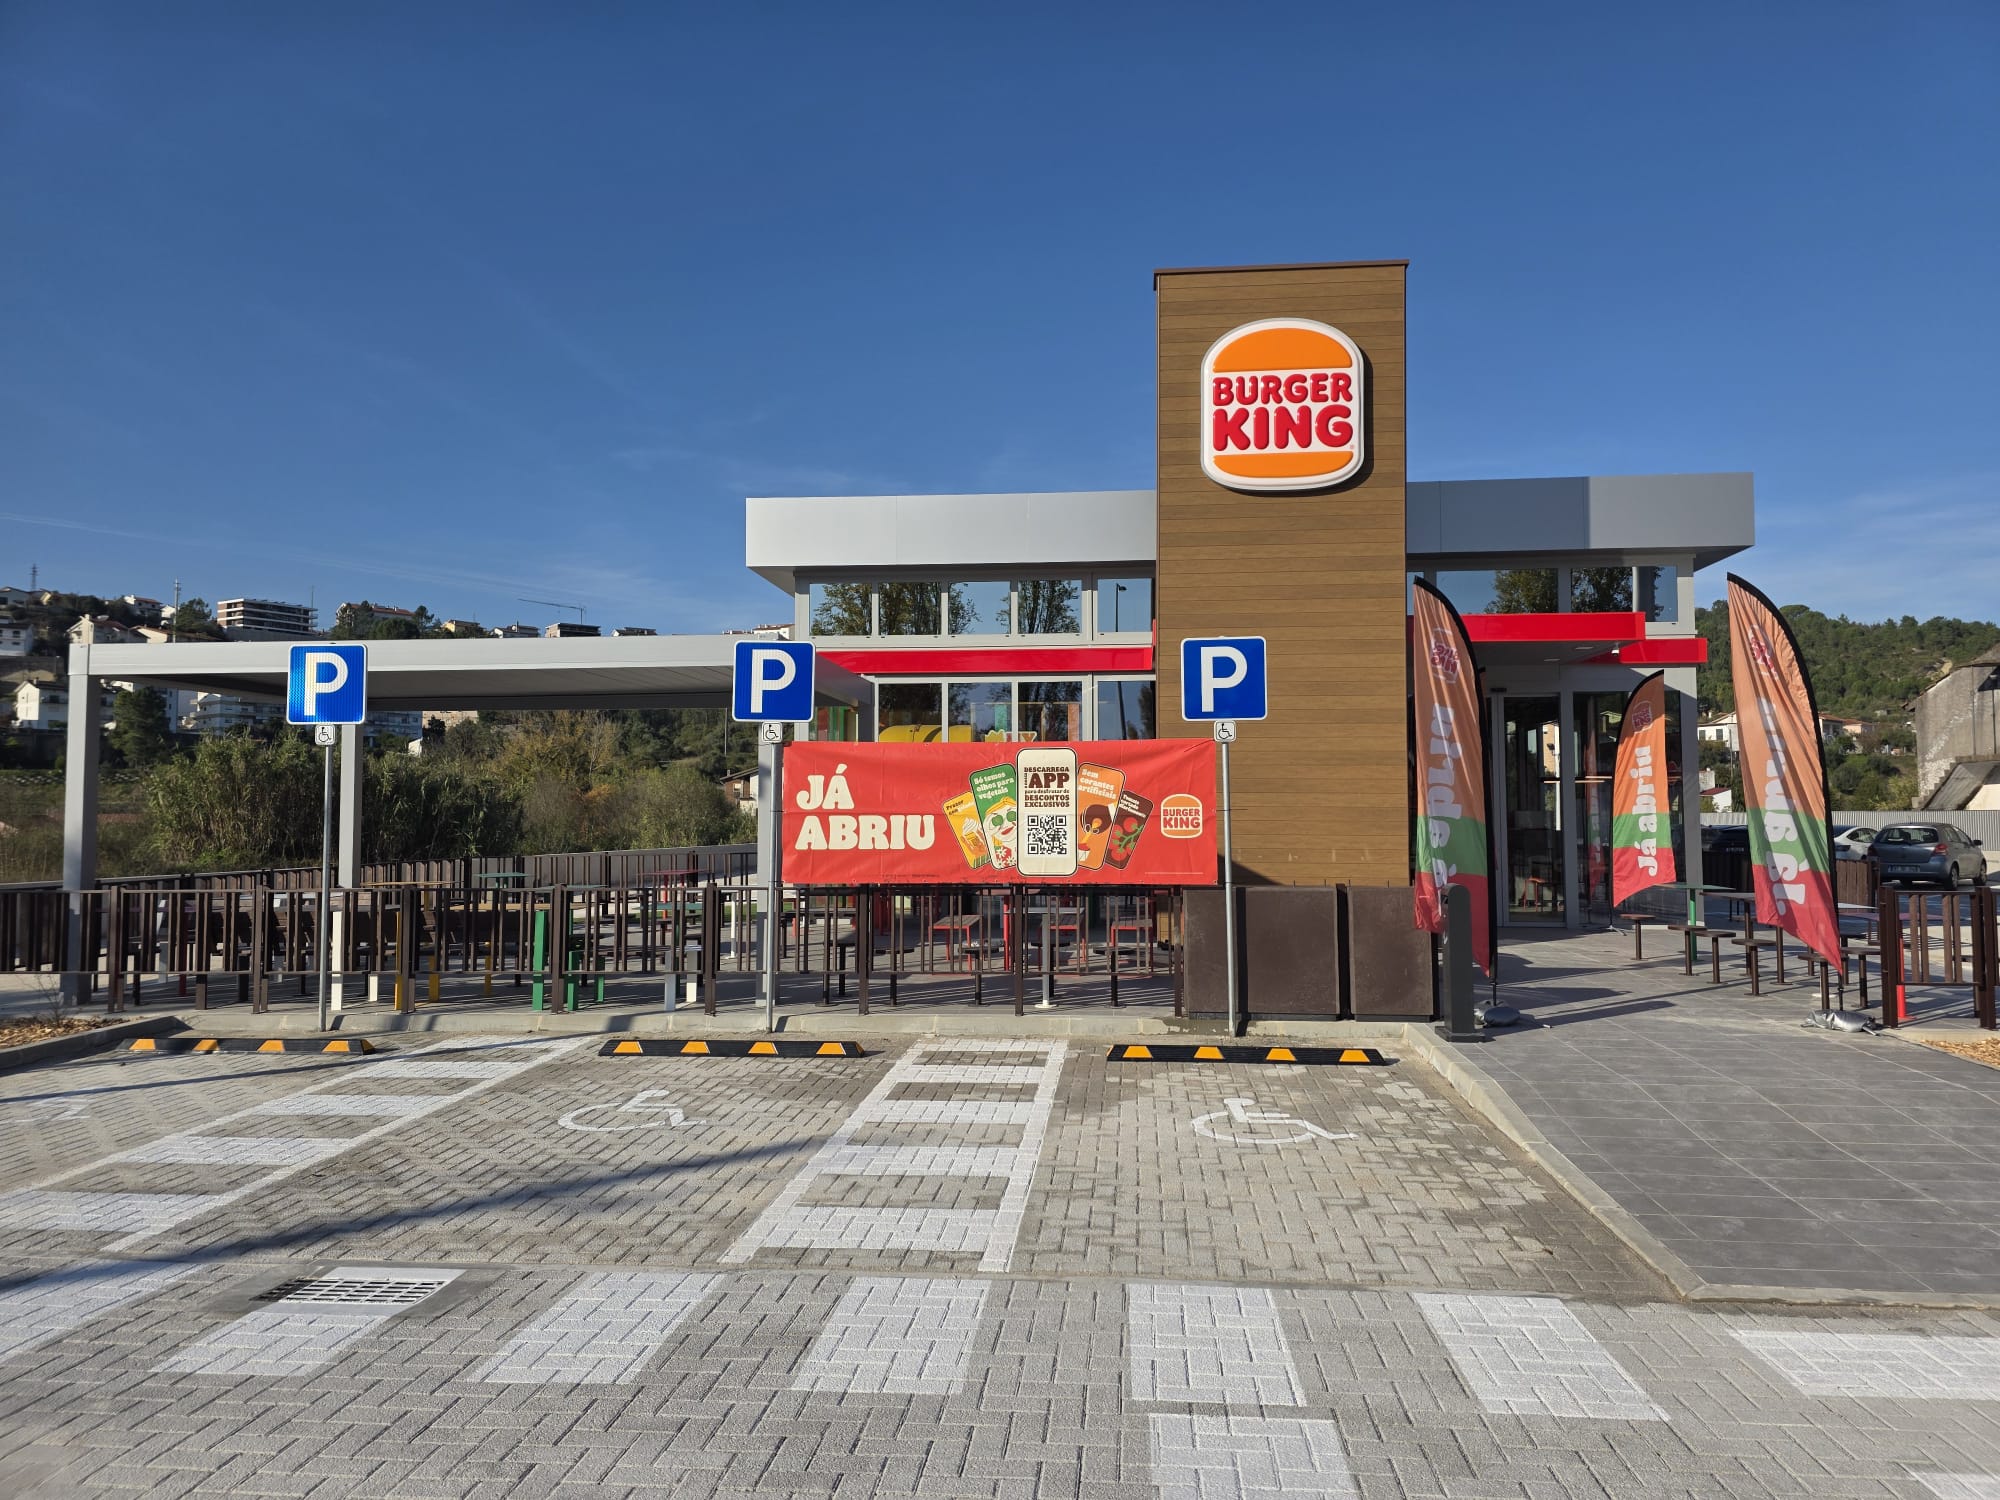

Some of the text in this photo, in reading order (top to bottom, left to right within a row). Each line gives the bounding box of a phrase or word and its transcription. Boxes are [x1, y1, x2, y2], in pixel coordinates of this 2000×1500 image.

[1213, 373, 1353, 406] BURGER
[1213, 404, 1354, 451] KING
[304, 652, 348, 716] P
[751, 649, 796, 713] P
[1201, 646, 1247, 712] P
[796, 763, 854, 810] JÁ
[976, 782, 996, 792] olhos
[997, 777, 1014, 788] para
[984, 772, 1006, 782] temos
[1029, 773, 1070, 788] APP
[1080, 777, 1115, 790] corantes
[1081, 769, 1099, 778] Sem
[1629, 745, 1657, 833] abriu
[978, 786, 1009, 799] vegetais
[1078, 784, 1117, 799] artificiais
[795, 815, 935, 850] ABRIU
[1163, 817, 1200, 828] KING
[1633, 838, 1657, 877] Já
